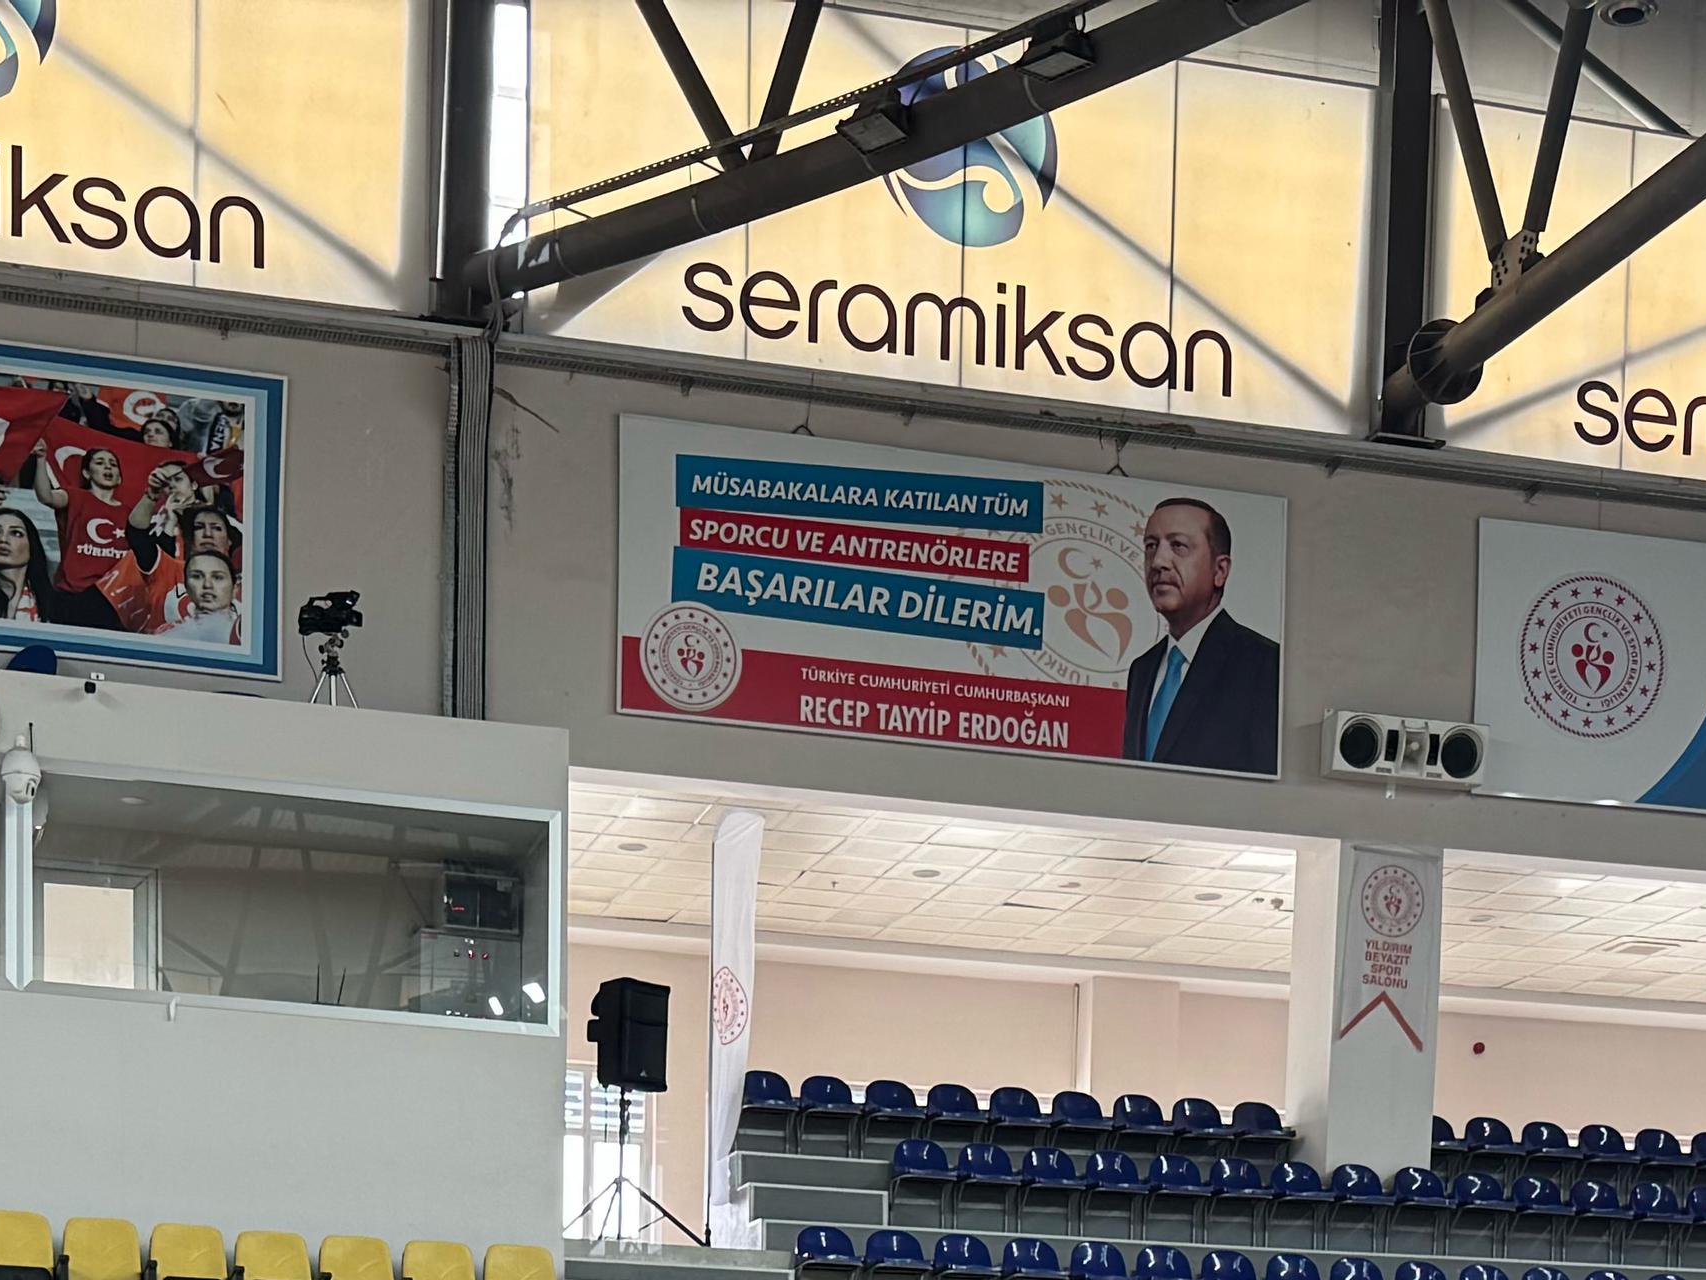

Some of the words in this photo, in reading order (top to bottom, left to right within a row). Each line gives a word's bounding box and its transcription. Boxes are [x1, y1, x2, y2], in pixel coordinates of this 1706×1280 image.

[681, 261, 1233, 398] seramiksan
[692, 472, 877, 507] MÜSABAKALARA
[884, 488, 977, 514] KATILAN
[982, 493, 1029, 518] TÜM
[689, 518, 789, 550] SPORCU
[796, 530, 824, 553] VE
[829, 534, 1021, 574] ANTRENÖRLERE
[696, 562, 890, 617] BAŞARILAR
[898, 584, 1042, 637] DİLERİM.
[801, 666, 856, 686] TÜRKİYE
[860, 672, 950, 696] CUMHURİYETİ
[954, 684, 1070, 708] CUMHURBAŞKANI
[800, 694, 870, 729] RECEP
[877, 698, 950, 737] TAYYİP
[958, 708, 1069, 749] ERDOĞAN
[1365, 939, 1412, 955] YILDIRIM
[1371, 963, 1401, 977] SPOR
[1362, 974, 1408, 989] SALONU
